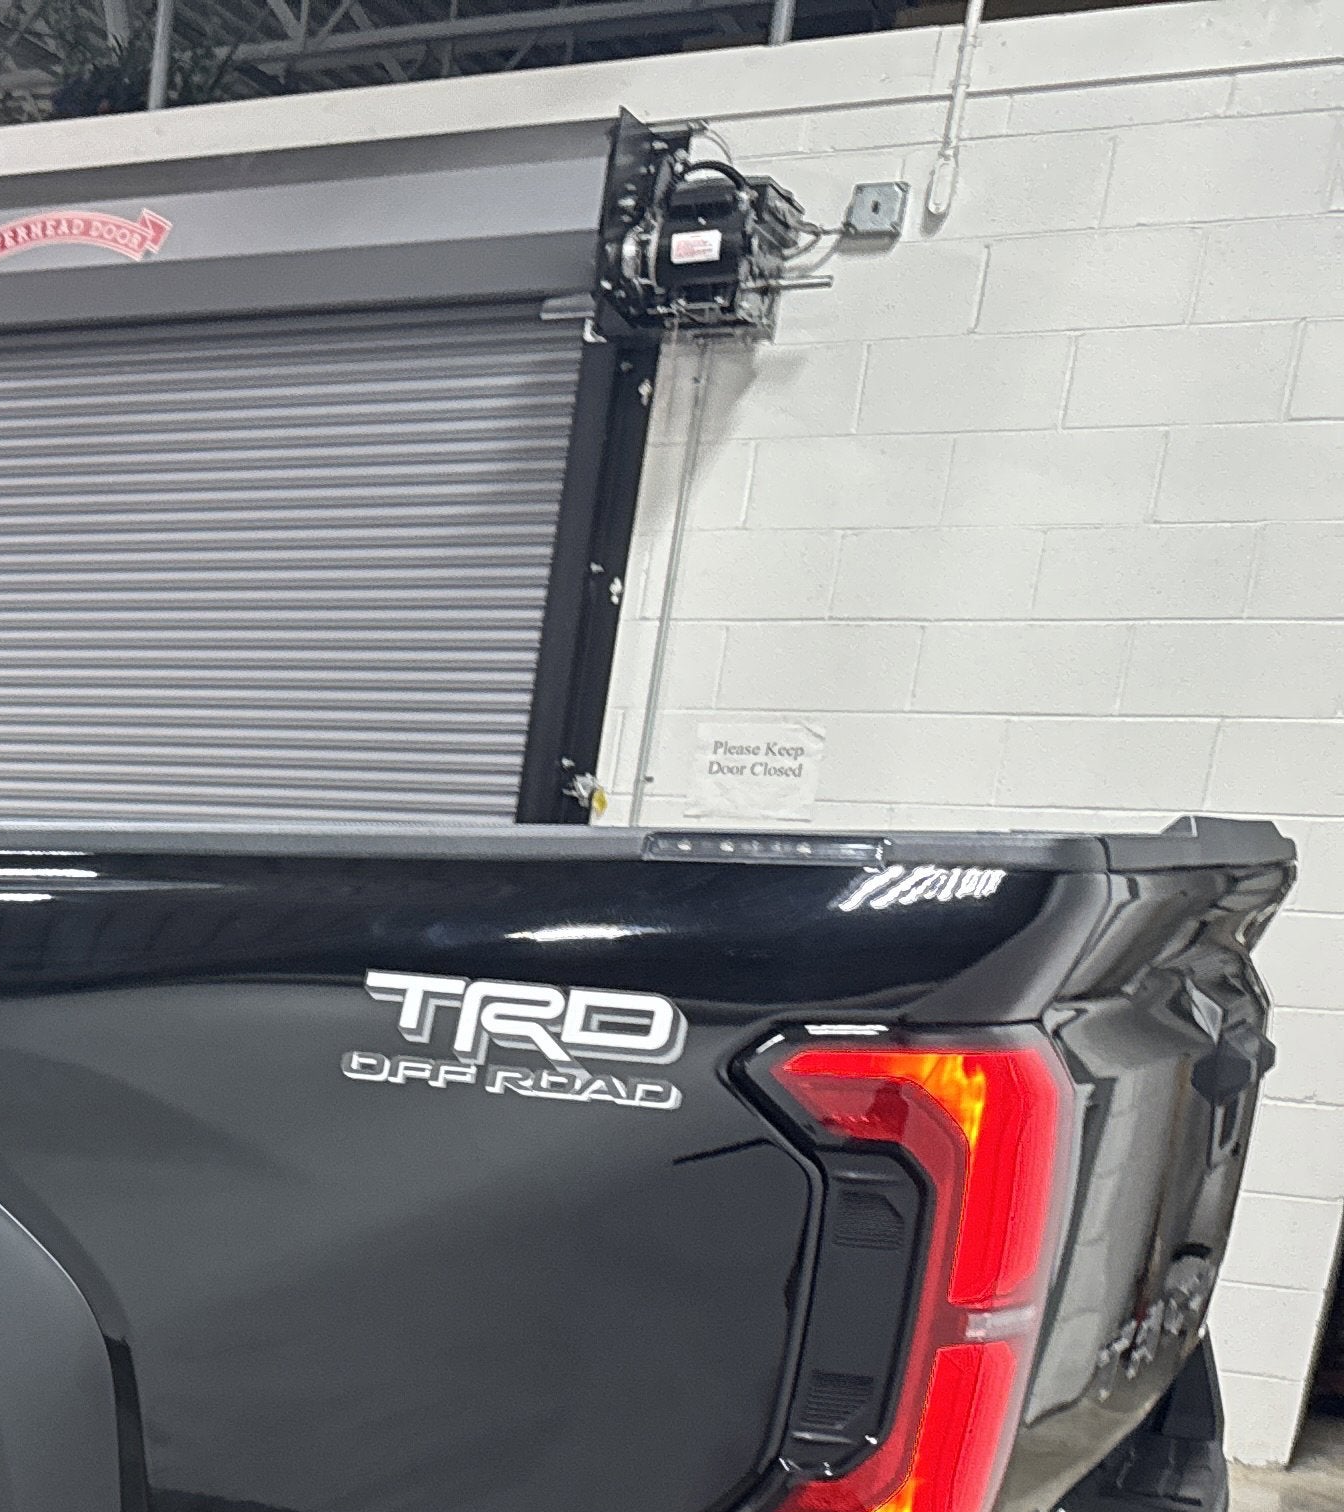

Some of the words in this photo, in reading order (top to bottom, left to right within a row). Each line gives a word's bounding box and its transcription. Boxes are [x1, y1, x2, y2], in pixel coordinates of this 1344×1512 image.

[88, 222, 141, 247] DOOR
[713, 741, 761, 756] Please
[764, 742, 805, 760] Keep
[709, 761, 747, 777] Door
[750, 763, 803, 778] Closed
[365, 968, 689, 1066] TRD
[340, 1050, 477, 1088] OFF
[485, 1064, 682, 1111] ROAD
